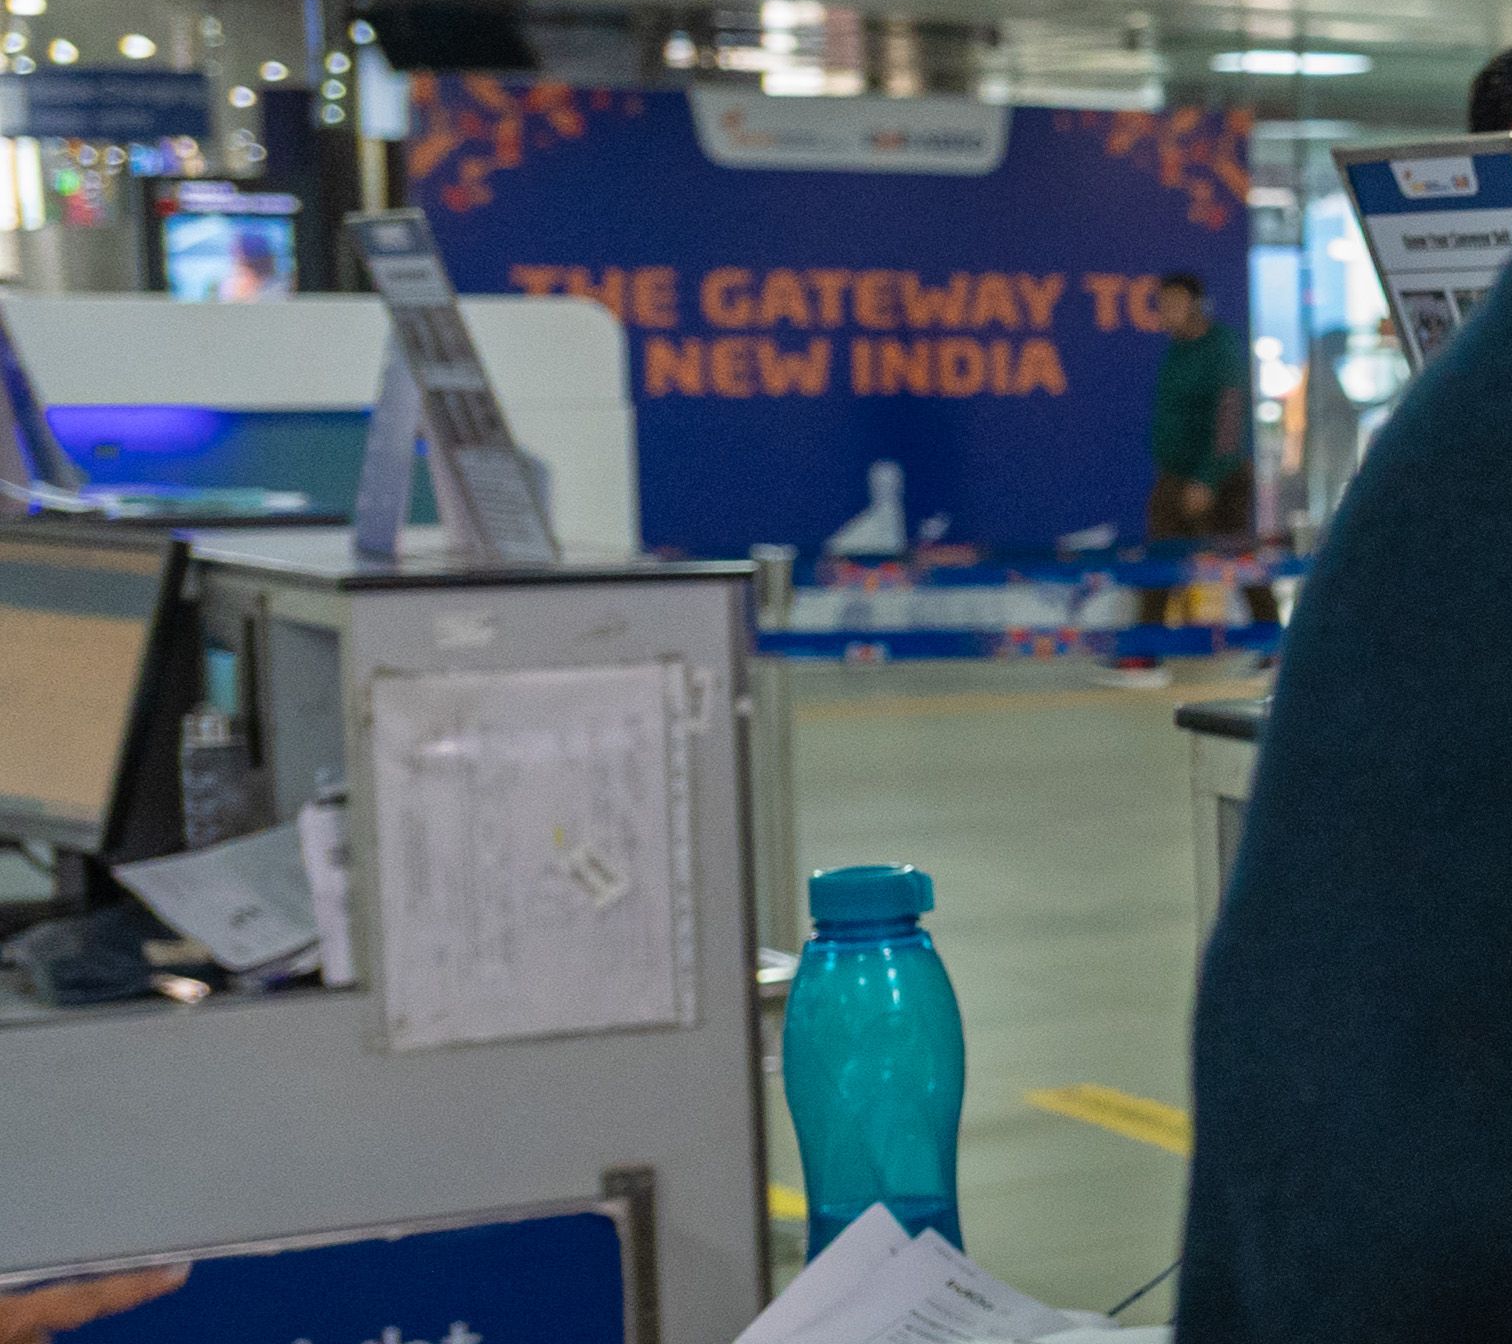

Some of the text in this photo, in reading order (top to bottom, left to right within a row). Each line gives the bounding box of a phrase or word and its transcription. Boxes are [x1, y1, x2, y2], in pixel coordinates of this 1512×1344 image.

[510, 264, 678, 328] THE
[700, 265, 1069, 332] GATEWAY
[644, 337, 1069, 400] NEW INDIA
